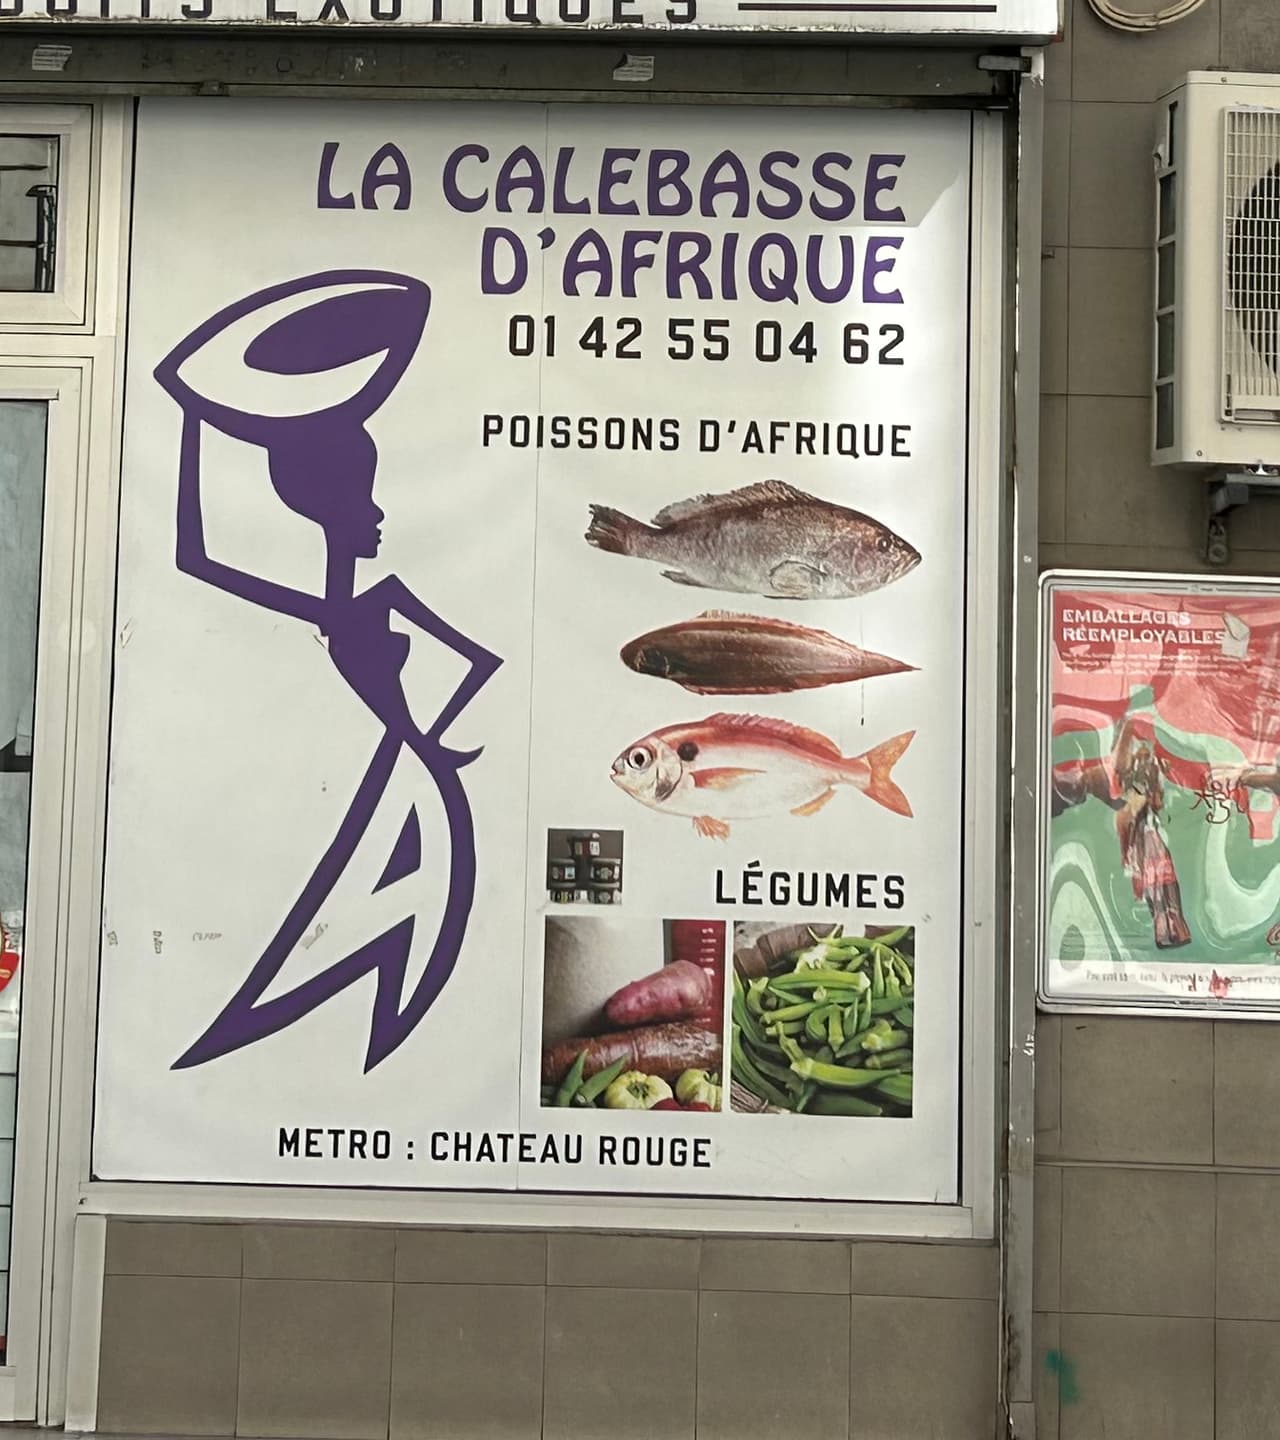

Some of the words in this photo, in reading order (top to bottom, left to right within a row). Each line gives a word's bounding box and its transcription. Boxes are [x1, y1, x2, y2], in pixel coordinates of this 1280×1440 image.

[318, 142, 411, 210] LA
[443, 144, 905, 222] CALEBASSE
[481, 227, 904, 305] D'AFRIQUE
[509, 315, 555, 357] 01
[579, 317, 641, 359] 42
[668, 318, 729, 361] 55
[756, 321, 817, 363] 04
[844, 323, 904, 365] 62
[483, 415, 679, 450] POISSONS
[700, 420, 911, 459] D'AFRIQUE
[1062, 608, 1191, 627] EMBALLAGES
[716, 861, 904, 909] LÉGUMES
[279, 1128, 390, 1159] METRO
[431, 1132, 581, 1163] CHATEAU
[600, 1136, 711, 1167] ROUGE
